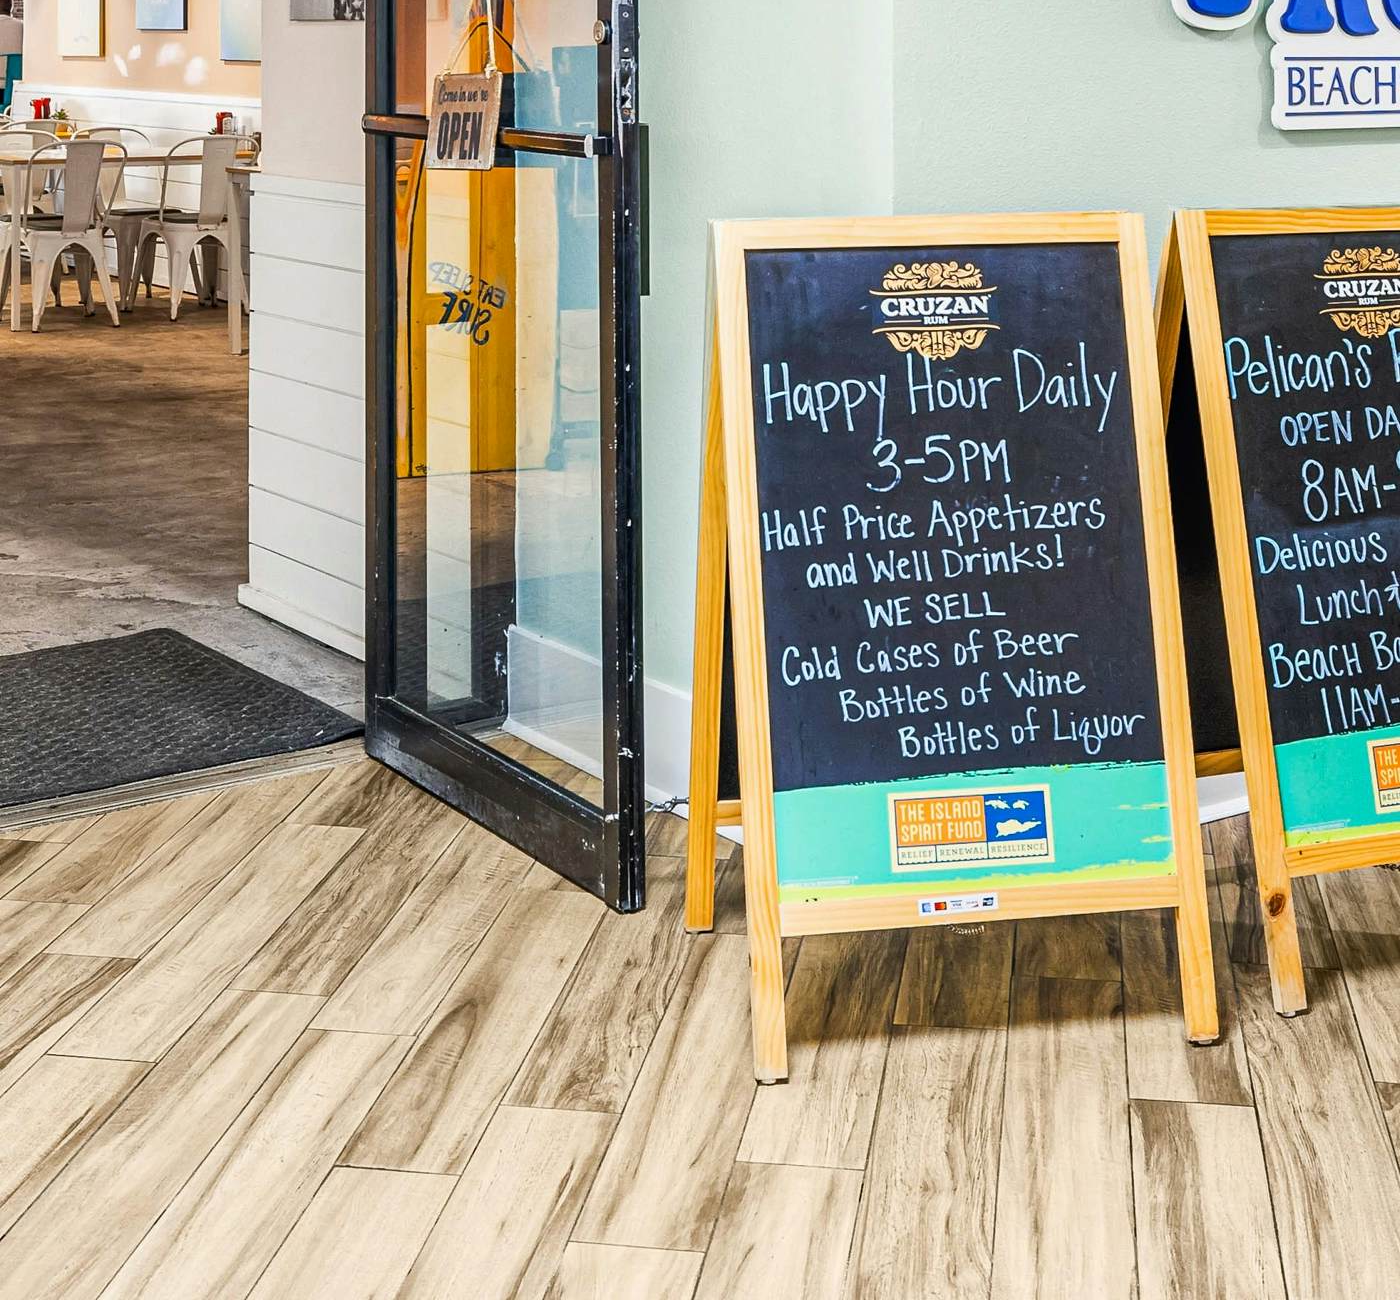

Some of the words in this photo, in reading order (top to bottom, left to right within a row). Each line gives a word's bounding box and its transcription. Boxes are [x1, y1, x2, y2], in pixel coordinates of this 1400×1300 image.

[1287, 66, 1396, 107] BEACH
[437, 111, 483, 159] OPEN
[881, 295, 989, 317] CRUZAN
[923, 316, 949, 325] RUM
[1358, 297, 1379, 305] RUM
[1224, 335, 1372, 400] Pelican's
[763, 362, 886, 441] Happy
[906, 353, 1001, 414] Hour
[1012, 342, 1117, 432] Daily
[1280, 410, 1352, 447] OPEN
[1302, 451, 1400, 523] 8AM-
[762, 506, 825, 552] Half
[844, 504, 915, 541] Price
[927, 494, 1105, 547] Appetizers
[806, 553, 857, 589] and
[866, 551, 931, 584] Well
[941, 534, 1064, 578] Drinks!
[1256, 532, 1388, 575] Delicious
[864, 598, 911, 629] WE
[925, 591, 1006, 622] SELL
[1297, 579, 1384, 625] Lunch
[782, 645, 841, 687] Cold
[857, 641, 940, 674] Cases
[954, 630, 981, 665] of
[992, 629, 1079, 660] Beer
[839, 685, 948, 723] Bottles
[962, 672, 990, 706] of
[1003, 667, 1086, 698] Wine
[898, 721, 999, 758] Bottles
[1012, 708, 1041, 742] of
[1051, 708, 1145, 755] Liquor
[1377, 749, 1399, 766] THE
[900, 803, 924, 822] THE
[931, 800, 981, 820] ISLAND
[901, 822, 943, 842] SPIRIT
[948, 820, 983, 840] FUND
[901, 849, 934, 859] RELIEF
[939, 846, 985, 857] RENEWAL
[991, 842, 1045, 854] RESILIENCE
